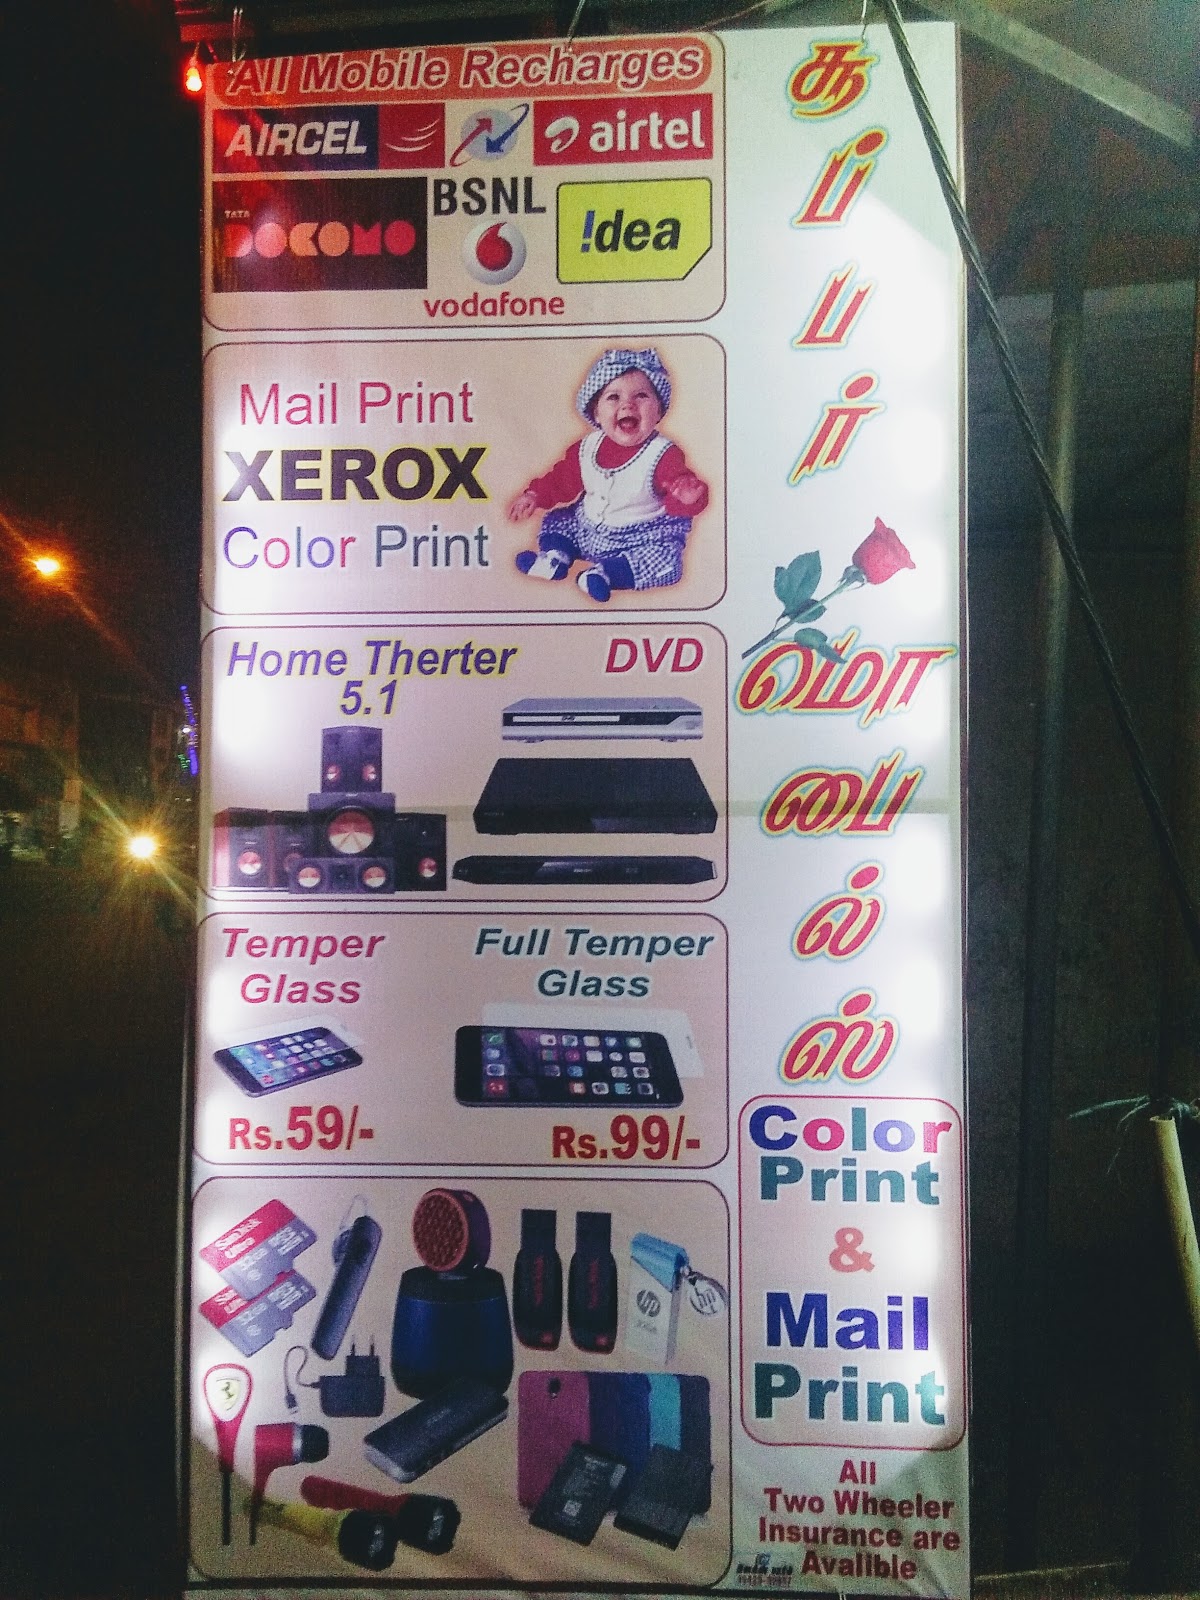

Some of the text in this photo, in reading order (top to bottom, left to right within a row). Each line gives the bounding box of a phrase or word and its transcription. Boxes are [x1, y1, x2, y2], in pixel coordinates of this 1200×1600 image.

[229, 43, 703, 97] All Mobile Recharges
[224, 120, 368, 158] AIRCEL
[590, 110, 705, 152] airtel
[433, 177, 546, 217] BSNL
[224, 220, 417, 259] DOCOMO
[423, 291, 565, 318] vodafone
[240, 381, 474, 425] Mail Print
[222, 446, 488, 502] XEROX
[223, 524, 489, 569] Color Print
[227, 639, 518, 677] Home Therter
[605, 637, 705, 674] DVD
[340, 680, 396, 716] 5.1
[222, 927, 385, 966] Temper
[475, 928, 714, 963] Full Temper
[240, 973, 361, 1005] Glass
[537, 968, 650, 998] Glass
[228, 1105, 375, 1152] Rs.59/-
[552, 1114, 701, 1162] Rs.99/-
[748, 1104, 952, 1153] Color
[760, 1155, 940, 1206] Print
[828, 1226, 876, 1273] &
[766, 1291, 929, 1351] Mail
[754, 1362, 946, 1426] Print
[839, 1459, 876, 1485] All
[763, 1487, 956, 1520] Two Wheeler
[759, 1516, 961, 1551] Insurance are
[801, 1550, 919, 1580] Avalible
